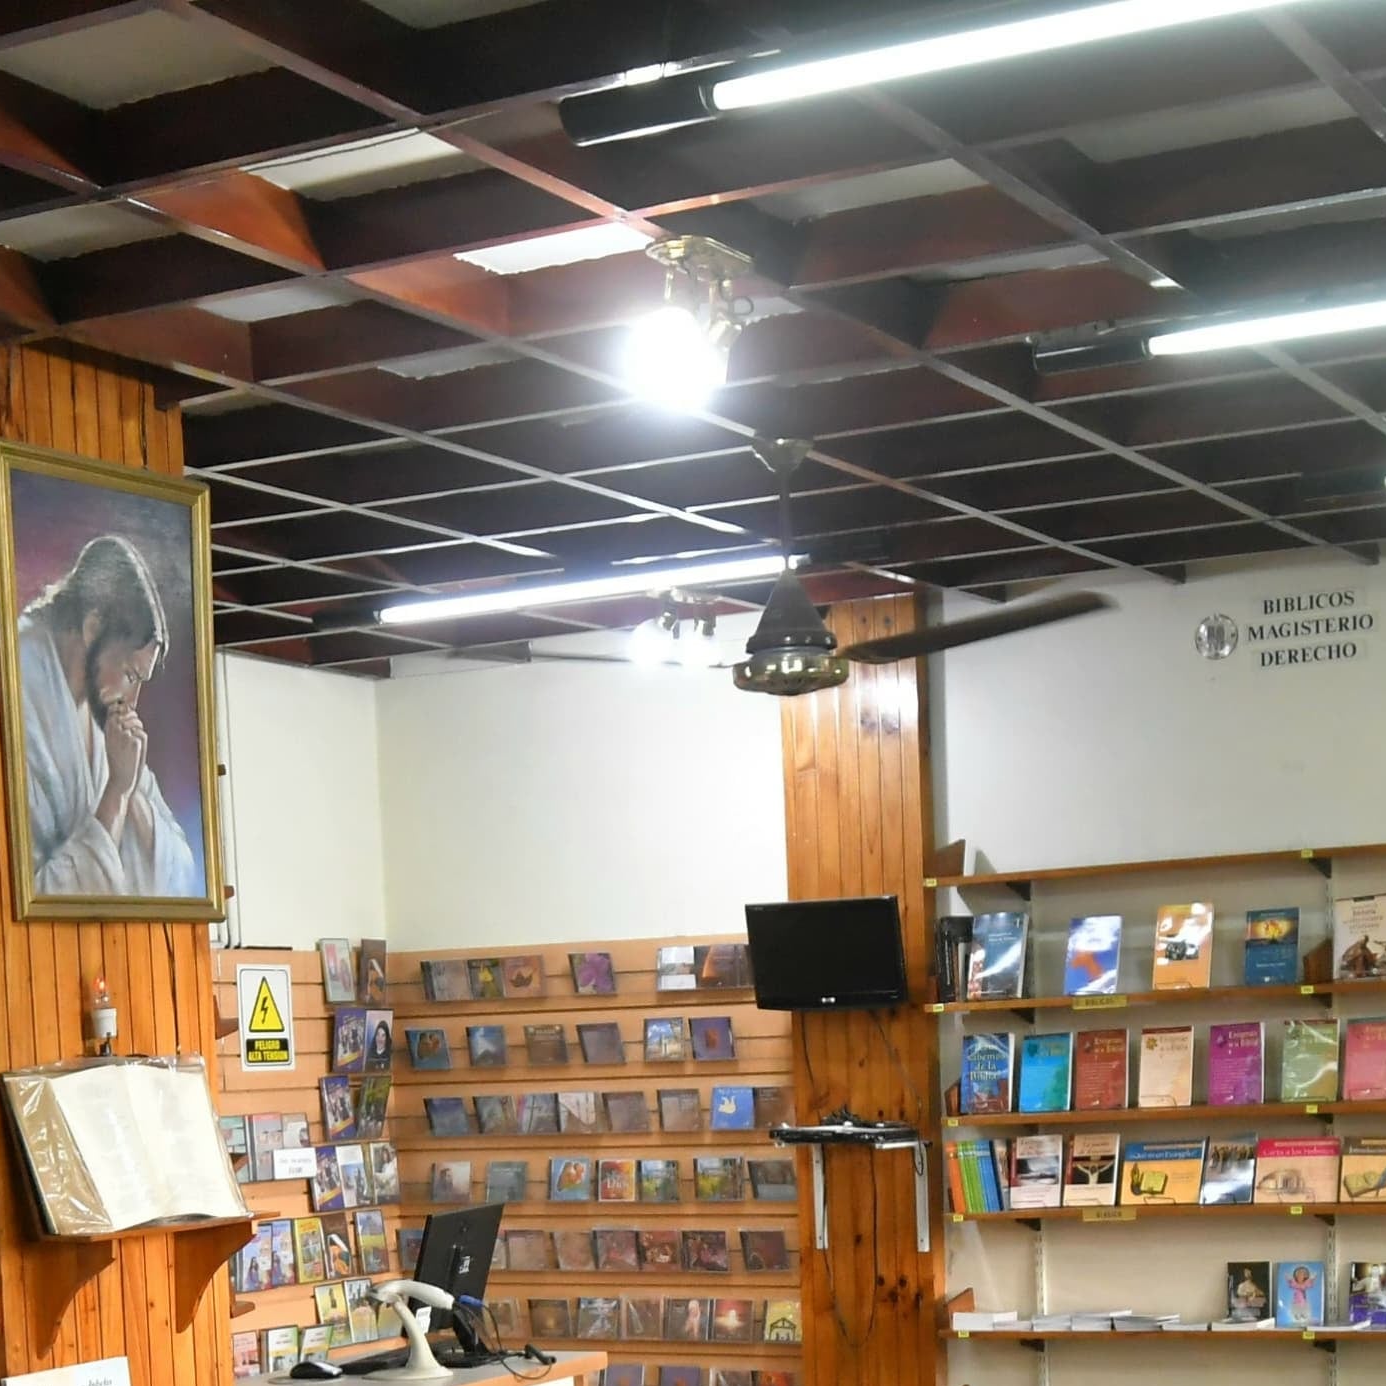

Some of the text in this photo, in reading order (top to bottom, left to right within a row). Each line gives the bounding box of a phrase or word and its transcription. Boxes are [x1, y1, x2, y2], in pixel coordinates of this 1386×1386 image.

[1263, 591, 1355, 615] BIBLICOS
[1248, 614, 1374, 641] MAGISTERIO
[1261, 642, 1357, 667] DERECHO
